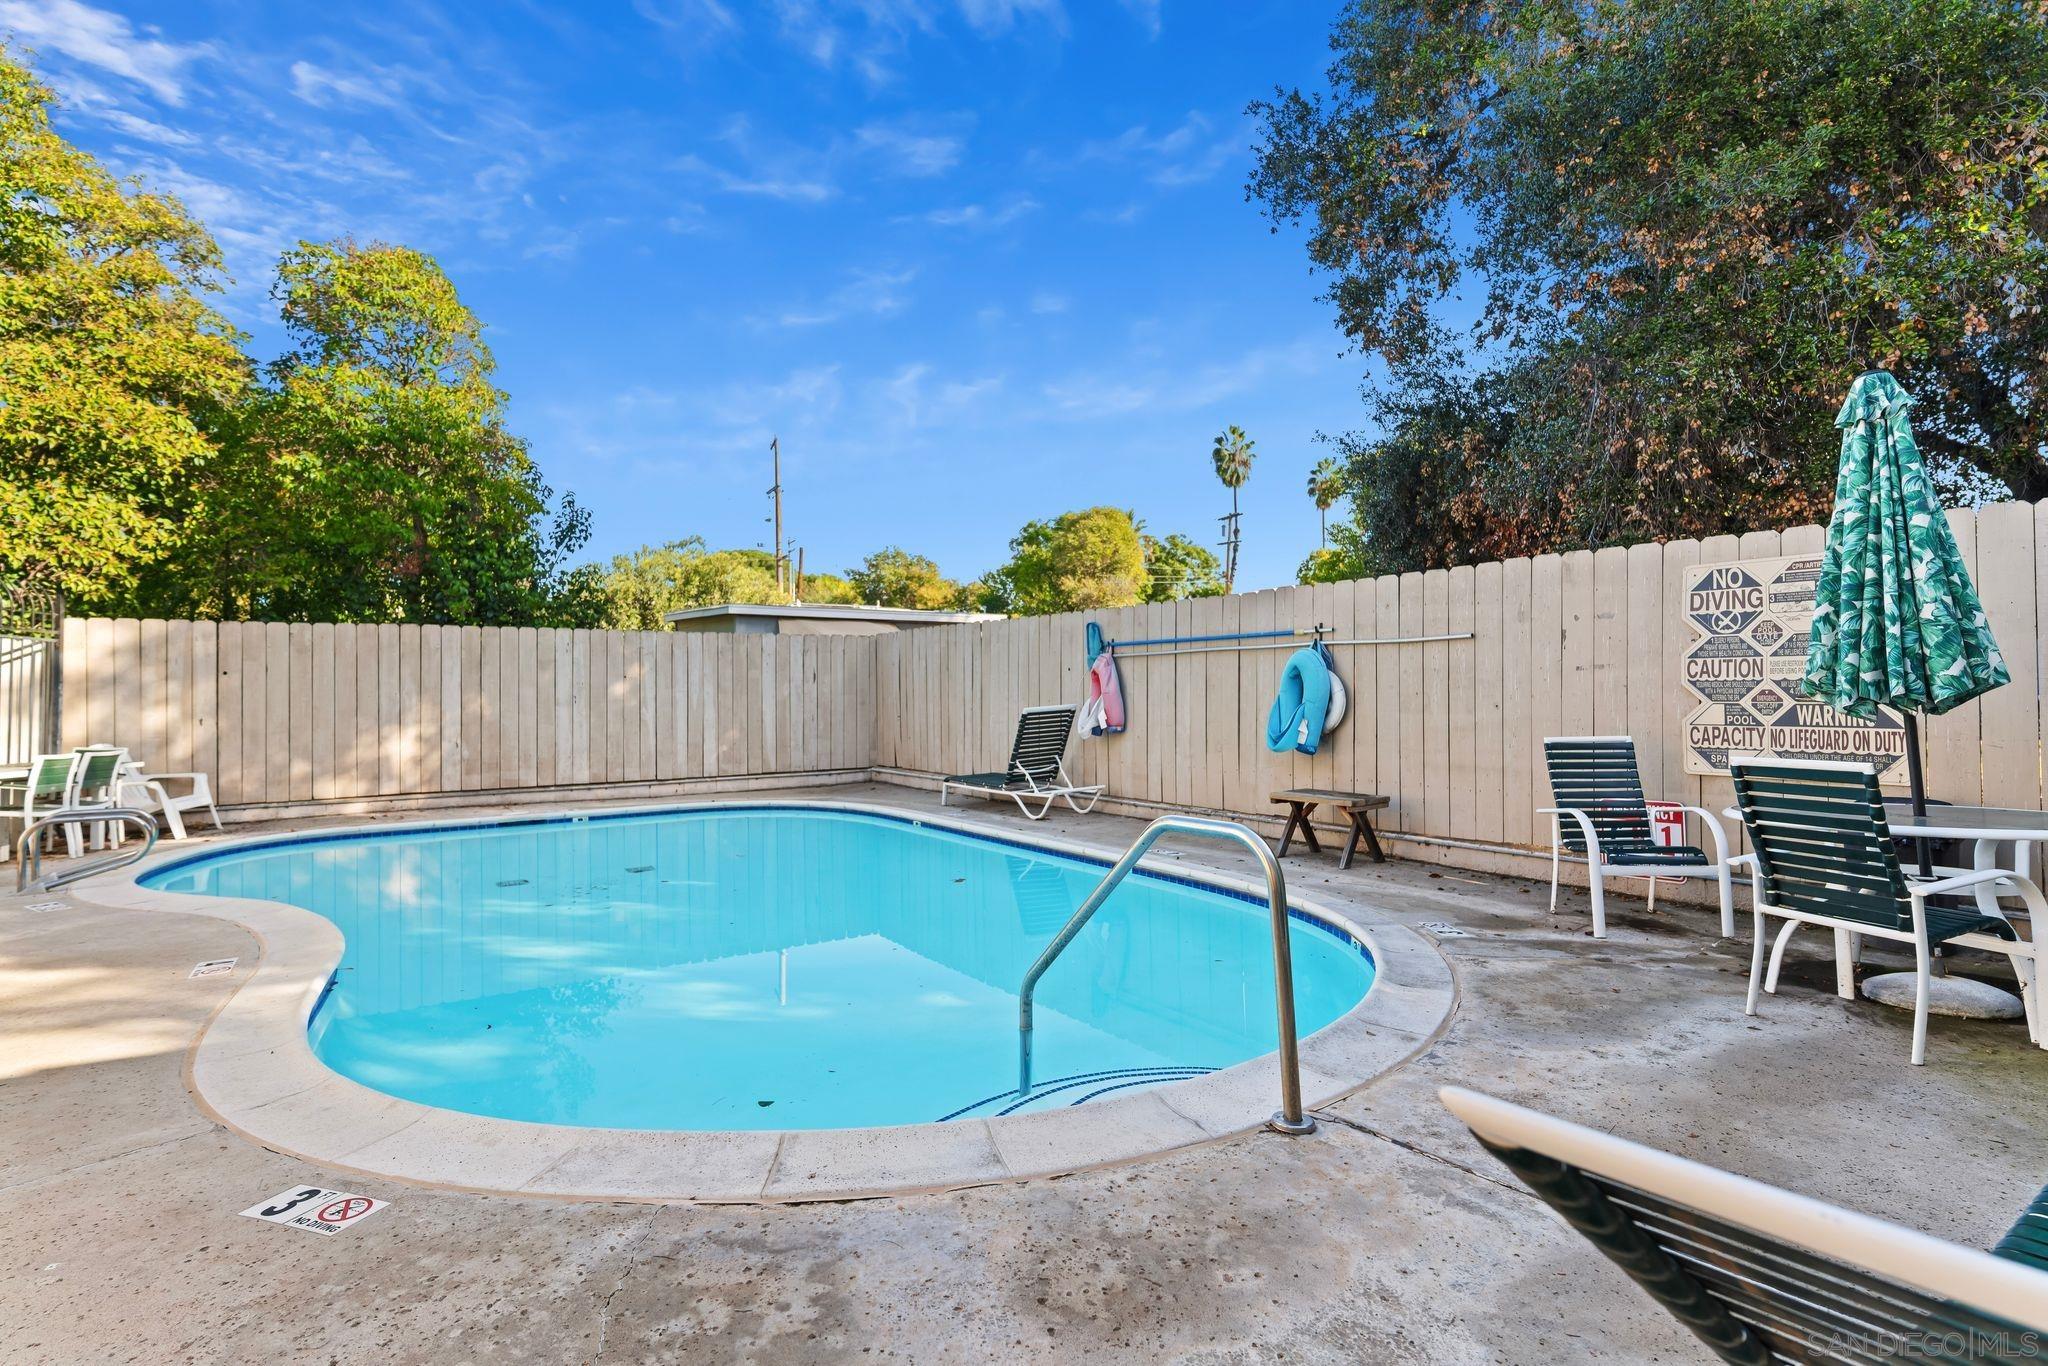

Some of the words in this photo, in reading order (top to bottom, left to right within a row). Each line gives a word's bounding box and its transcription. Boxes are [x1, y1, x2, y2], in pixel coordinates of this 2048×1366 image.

[1713, 567, 1743, 589] NO
[1690, 588, 1763, 611] DIVING
[1687, 658, 1763, 678] CAUTION
[1727, 715, 1755, 724] POOL
[1796, 704, 1876, 726] WARN
[1690, 726, 1766, 747] CAPACITY
[1770, 728, 1785, 748] NO
[1790, 729, 1849, 750] LIFEGUARD
[1853, 730, 1870, 751] ON
[1875, 731, 1905, 752] DUTY
[1711, 754, 1728, 762] SPA
[260, 1189, 321, 1216] 3
[318, 1191, 338, 1200] FT
[292, 1216, 311, 1225] NO
[306, 1220, 341, 1232] DIVING
